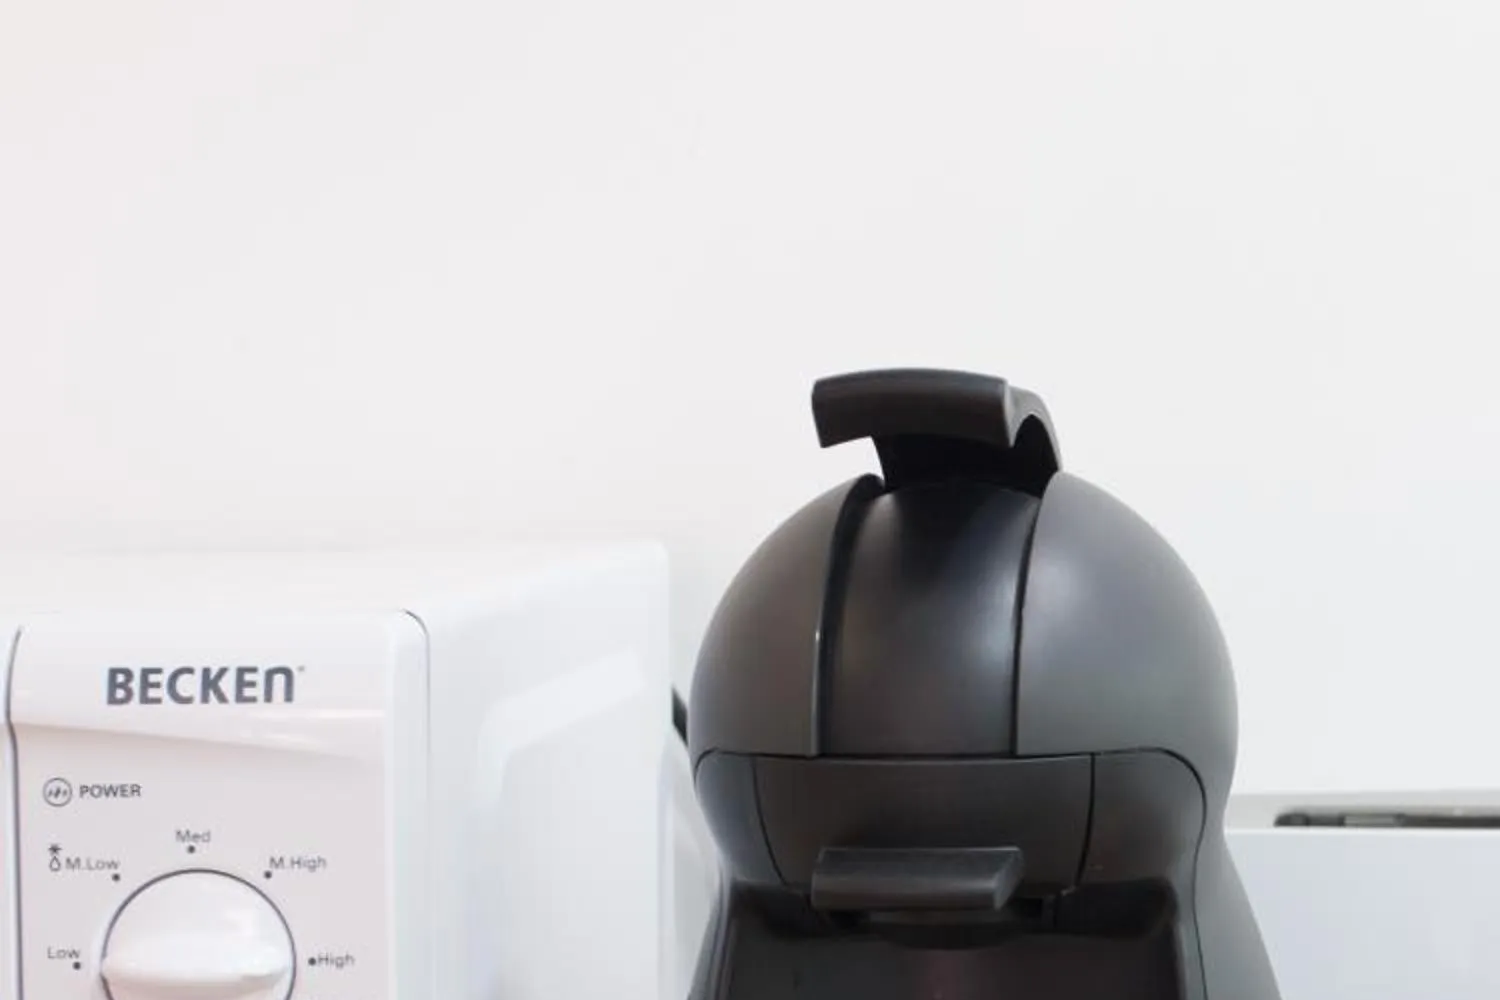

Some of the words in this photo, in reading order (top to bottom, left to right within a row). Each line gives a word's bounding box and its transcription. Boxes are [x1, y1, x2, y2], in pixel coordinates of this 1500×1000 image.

[106, 666, 295, 705] BECKEN
[79, 784, 142, 799] POWER
[175, 830, 211, 844] Med
[65, 857, 119, 871] M.Low
[269, 855, 327, 871] M.High
[47, 946, 81, 960] Low
[317, 952, 355, 968] High
